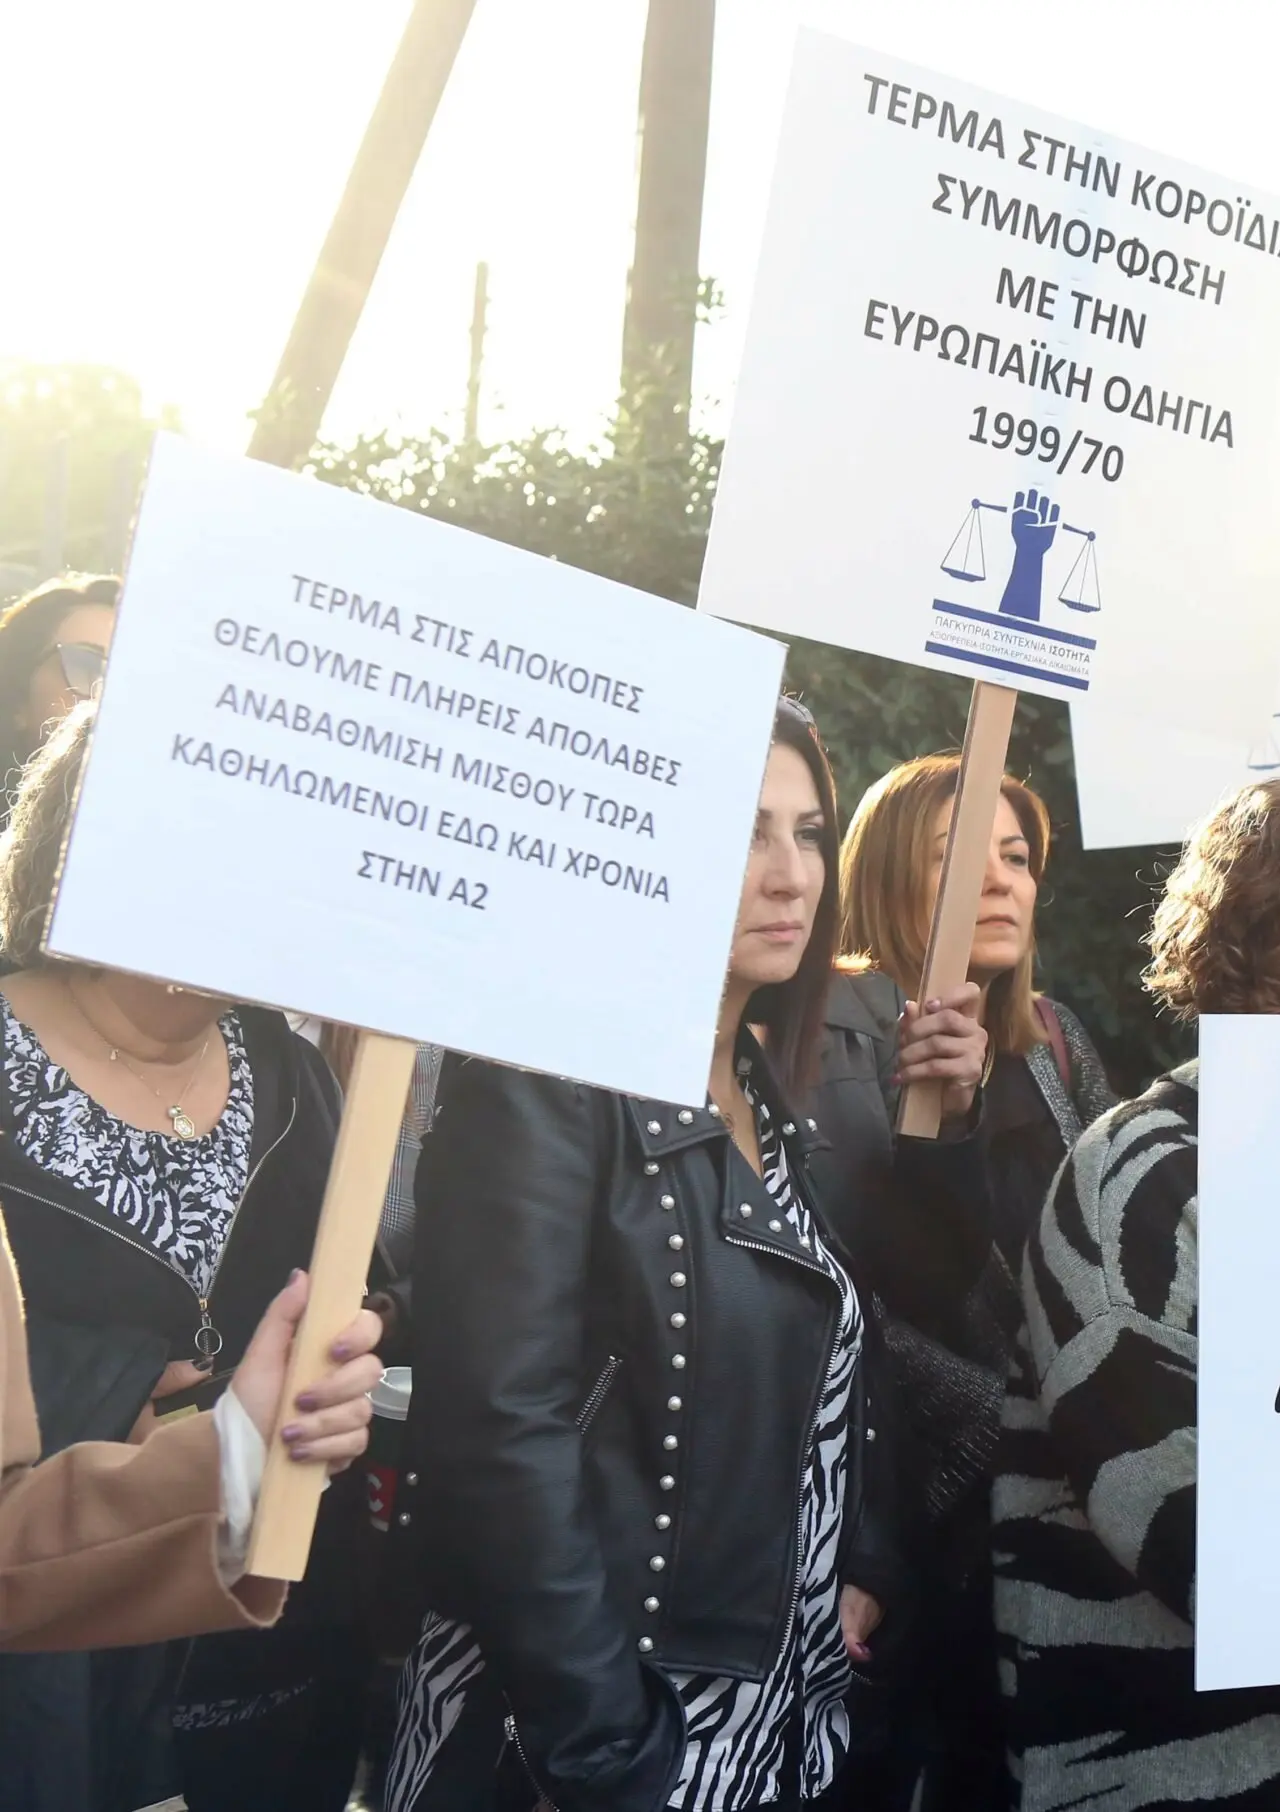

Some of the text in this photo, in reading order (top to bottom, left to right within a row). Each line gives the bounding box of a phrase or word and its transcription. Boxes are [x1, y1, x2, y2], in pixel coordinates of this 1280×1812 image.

[864, 74, 1005, 159] ΤΕΡΜΑ
[1018, 130, 1121, 197] ΣΤΗΝ
[932, 174, 1225, 304] ΣΥΜΜΟΡΦΩΣΗ
[996, 268, 1146, 349] ΜΕ ΤΗΝ
[864, 300, 1233, 448] ΕΥΡΩΠΑΪΚΗ ΟΔΗΓΙΑ
[969, 406, 1123, 482] 1999/70
[216, 619, 681, 786] ΘΕΛΟΥΜΕ ΠΛΗΡΕΙΣ ΑΠΟΛΑΒΕΣ
[293, 575, 644, 713] ΤΕΡΜΑ ΣΤΙΣ ΑΠΟΚΟΠΕΣ
[936, 616, 1090, 663] ΠΑΓΚΥΠΡΙΑ ΣΥΝΤΕΧΝΙΑ ΙΣΟΤΗΤΑ
[172, 734, 669, 902] ΚΑΘΗΛΩΜΕΝΟΙ ΕΔΩ ΚΑΙ ΧΡΟΝΙΑ
[216, 684, 654, 839] ΑΝΑΒΑΘΜΙΣΗ ΜΙΣΘΟΥ ΤΩΡΑ
[357, 851, 488, 910] ΣΤΗΝ Α2
